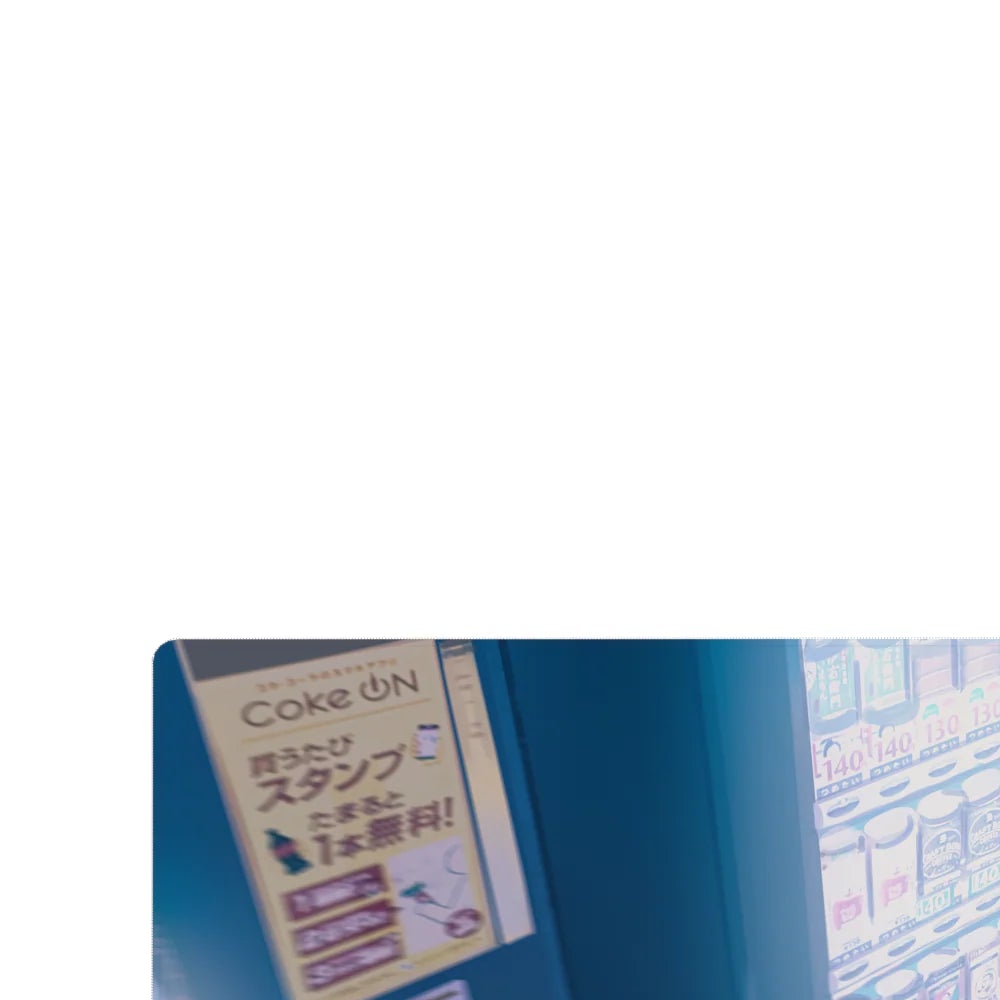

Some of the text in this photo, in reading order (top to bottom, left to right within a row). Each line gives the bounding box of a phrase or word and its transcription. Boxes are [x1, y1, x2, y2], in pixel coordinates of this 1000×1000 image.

[241, 687, 354, 727] Coke
[925, 713, 959, 744] 130
[873, 732, 913, 763] 140
[823, 749, 864, 782] 140
